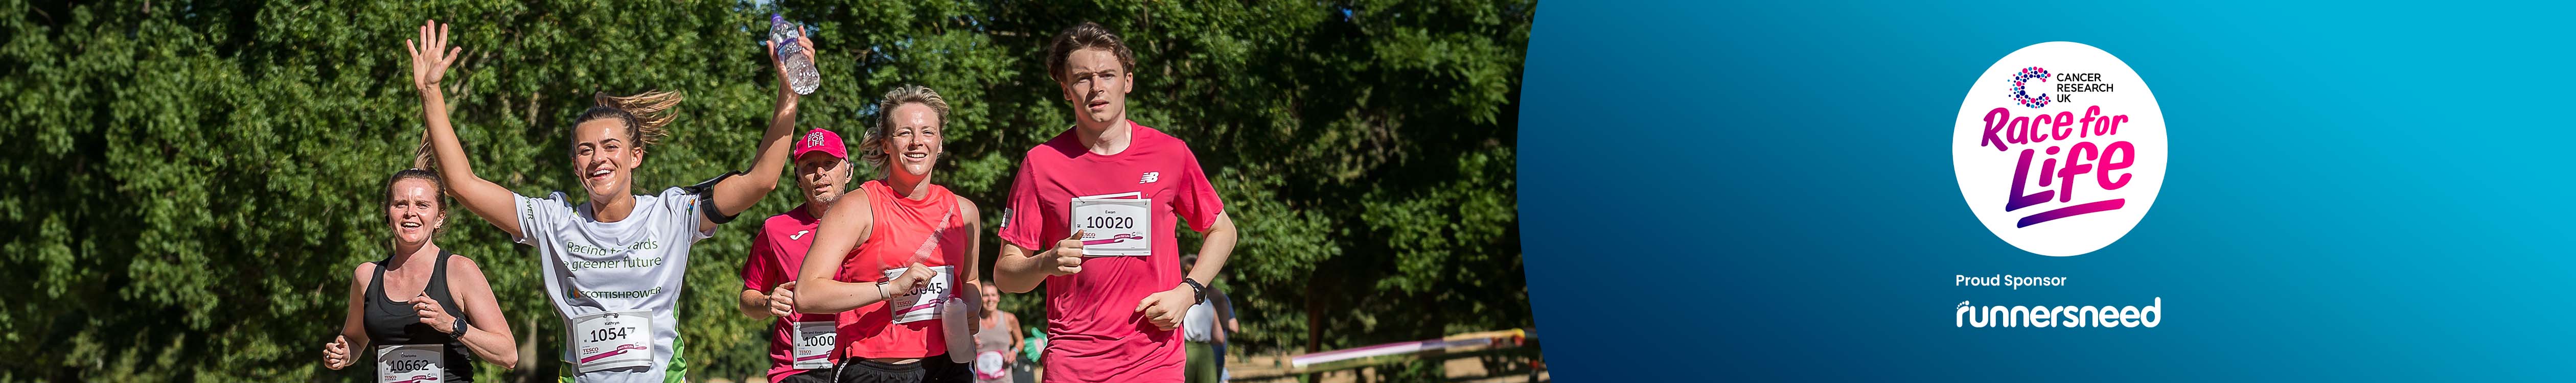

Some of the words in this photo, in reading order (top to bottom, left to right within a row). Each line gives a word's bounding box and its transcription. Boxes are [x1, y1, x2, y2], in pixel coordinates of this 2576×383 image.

[1087, 216, 1133, 229] 10020
[571, 260, 620, 271] greener
[623, 255, 661, 268] future
[590, 327, 635, 343] 10547
[390, 360, 429, 371] 10662
